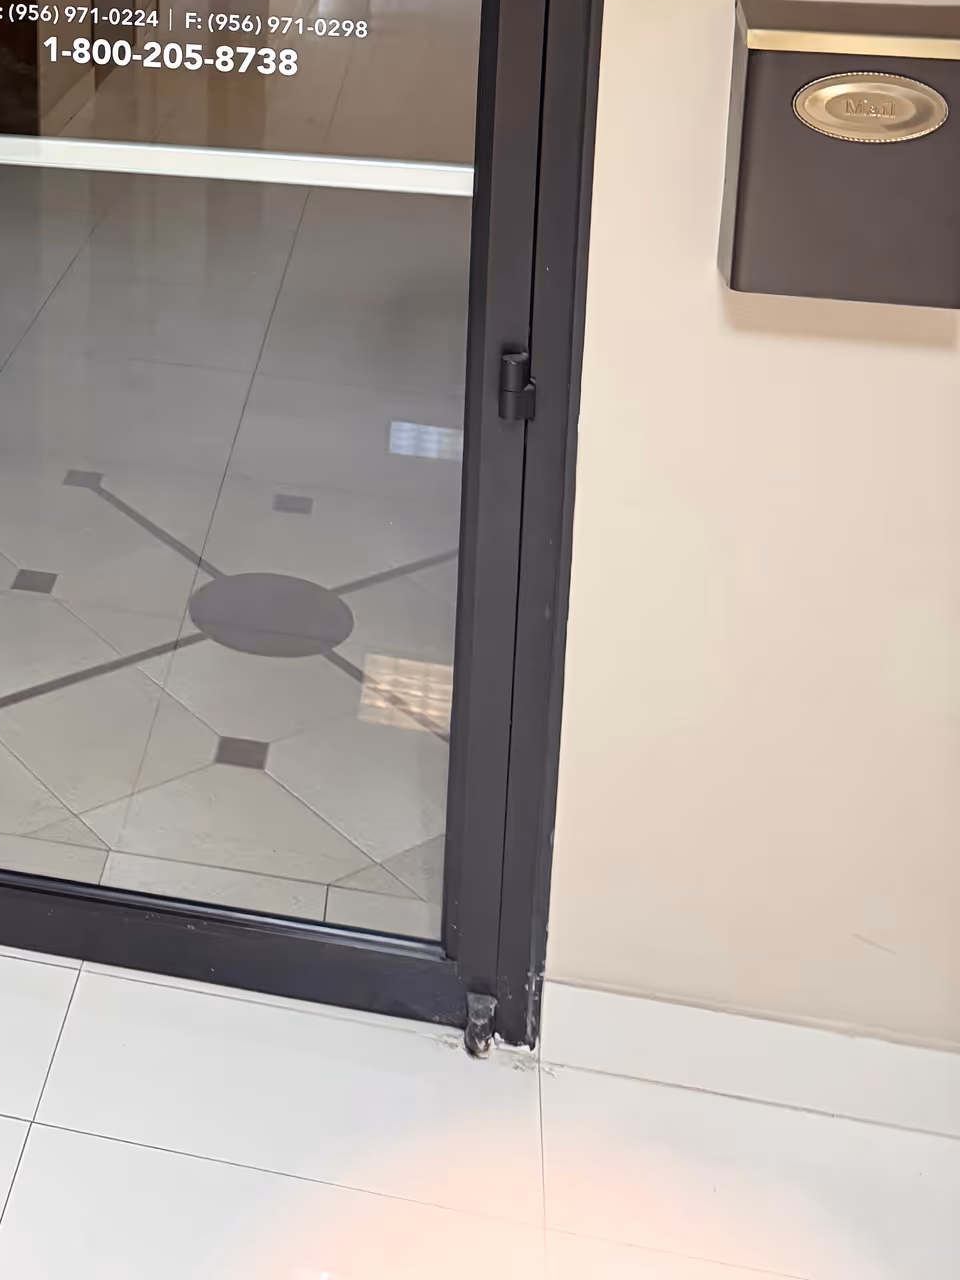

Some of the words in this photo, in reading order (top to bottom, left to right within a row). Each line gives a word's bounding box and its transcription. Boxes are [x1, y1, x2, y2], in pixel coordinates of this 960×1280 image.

[8, 3, 59, 25] (956)
[64, 6, 159, 27] 971-0224
[185, 13, 202, 30] F:
[208, 14, 262, 36] (956)
[267, 17, 369, 38] 971-0298
[44, 36, 298, 76] 1-800-205-8738
[844, 98, 897, 119] Mail
